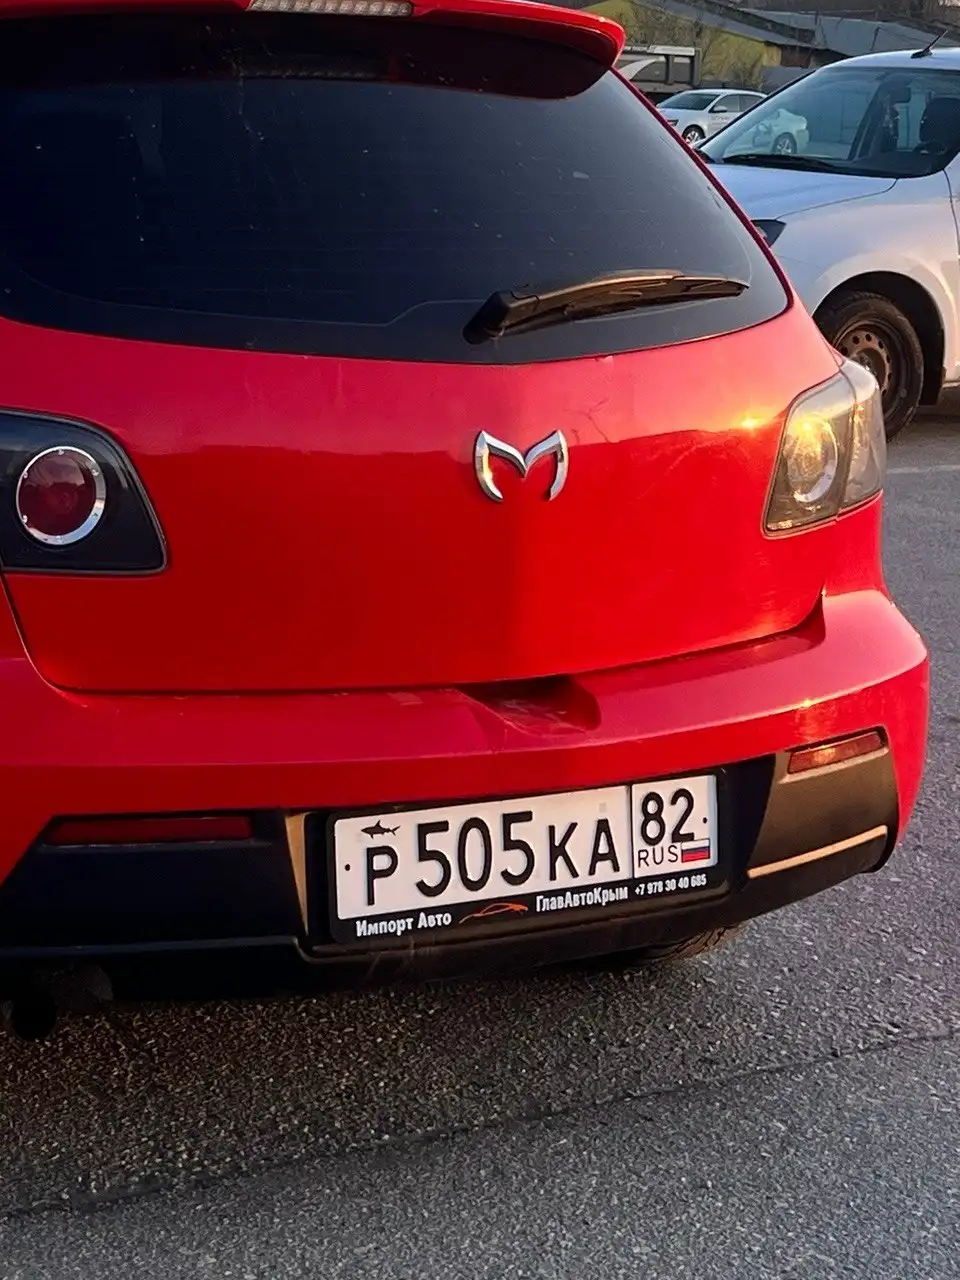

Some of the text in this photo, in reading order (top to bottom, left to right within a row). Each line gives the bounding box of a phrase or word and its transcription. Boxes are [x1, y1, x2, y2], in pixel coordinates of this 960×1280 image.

[641, 788, 694, 846] 82
[638, 844, 679, 868] RUS
[356, 917, 414, 937] Импорт
[417, 911, 452, 929] Авто
[536, 886, 628, 912] ГлавАвтоКрым
[635, 883, 645, 895] +7
[647, 881, 663, 894] 978
[678, 876, 689, 888] 40
